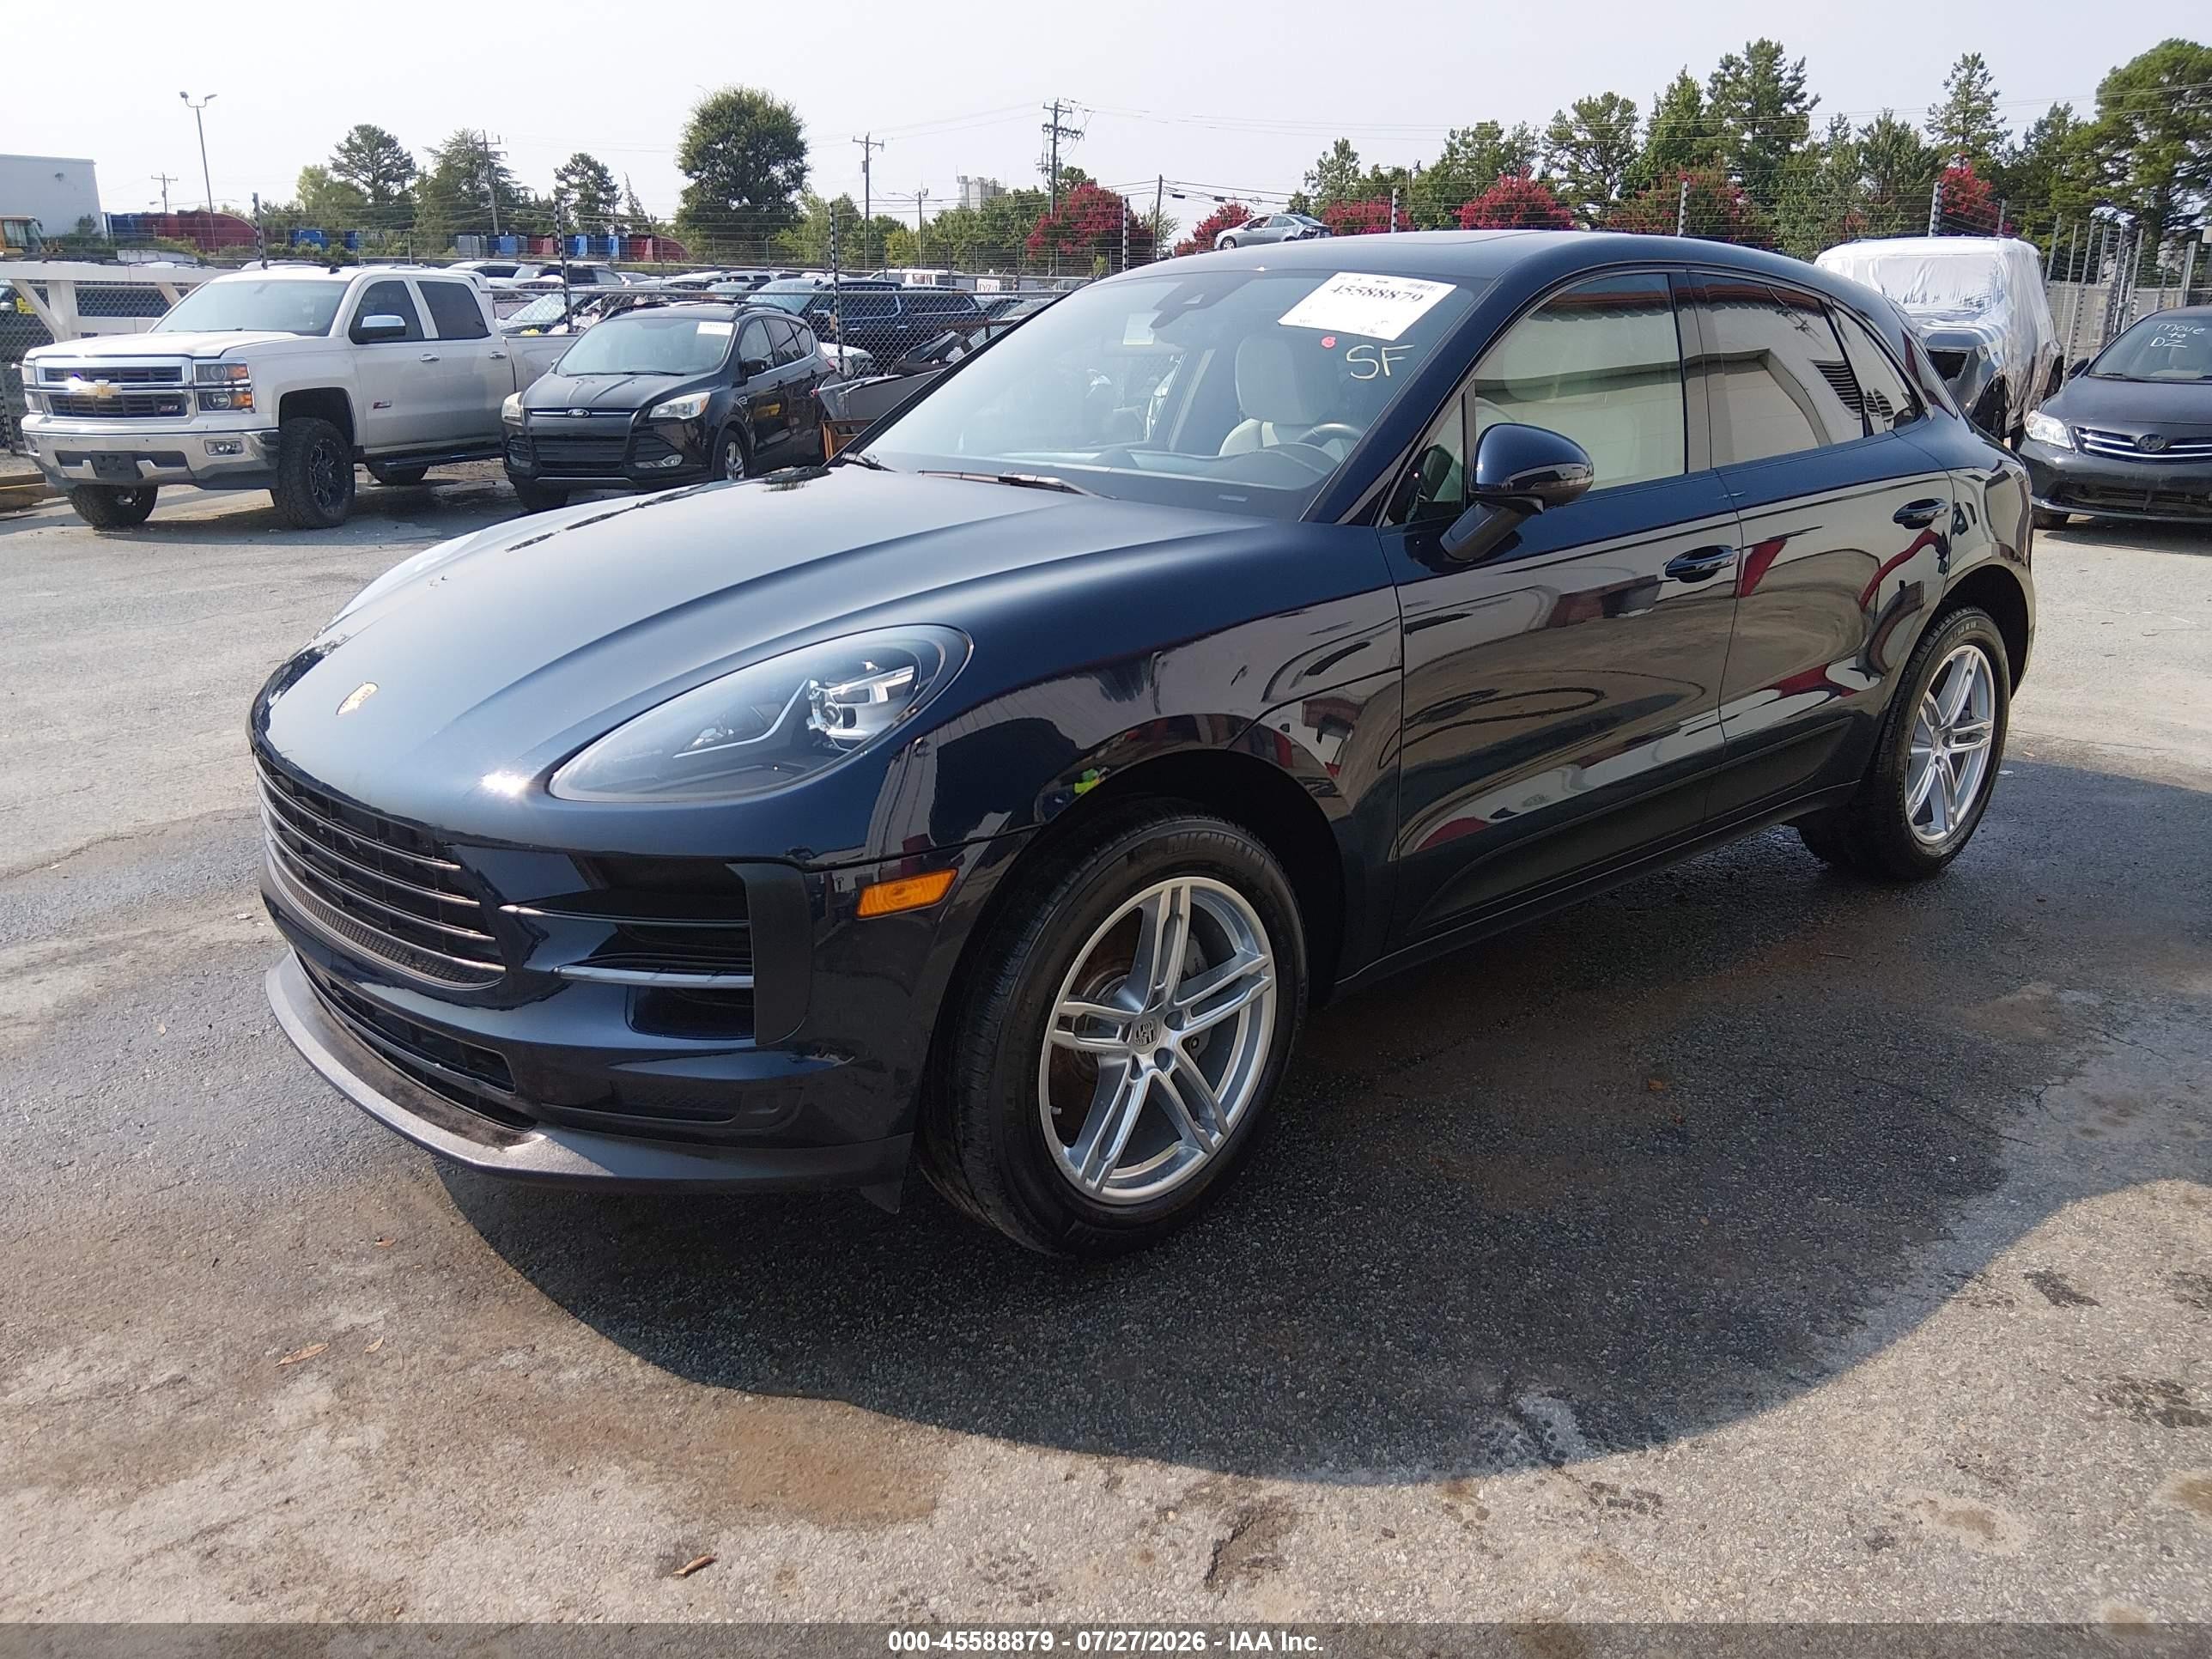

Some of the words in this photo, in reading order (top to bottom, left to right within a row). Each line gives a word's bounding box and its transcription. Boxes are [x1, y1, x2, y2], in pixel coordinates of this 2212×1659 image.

[1329, 283, 1425, 303] 45588879
[1346, 343, 1415, 380] SF
[1168, 831, 1266, 866] MICHELIN
